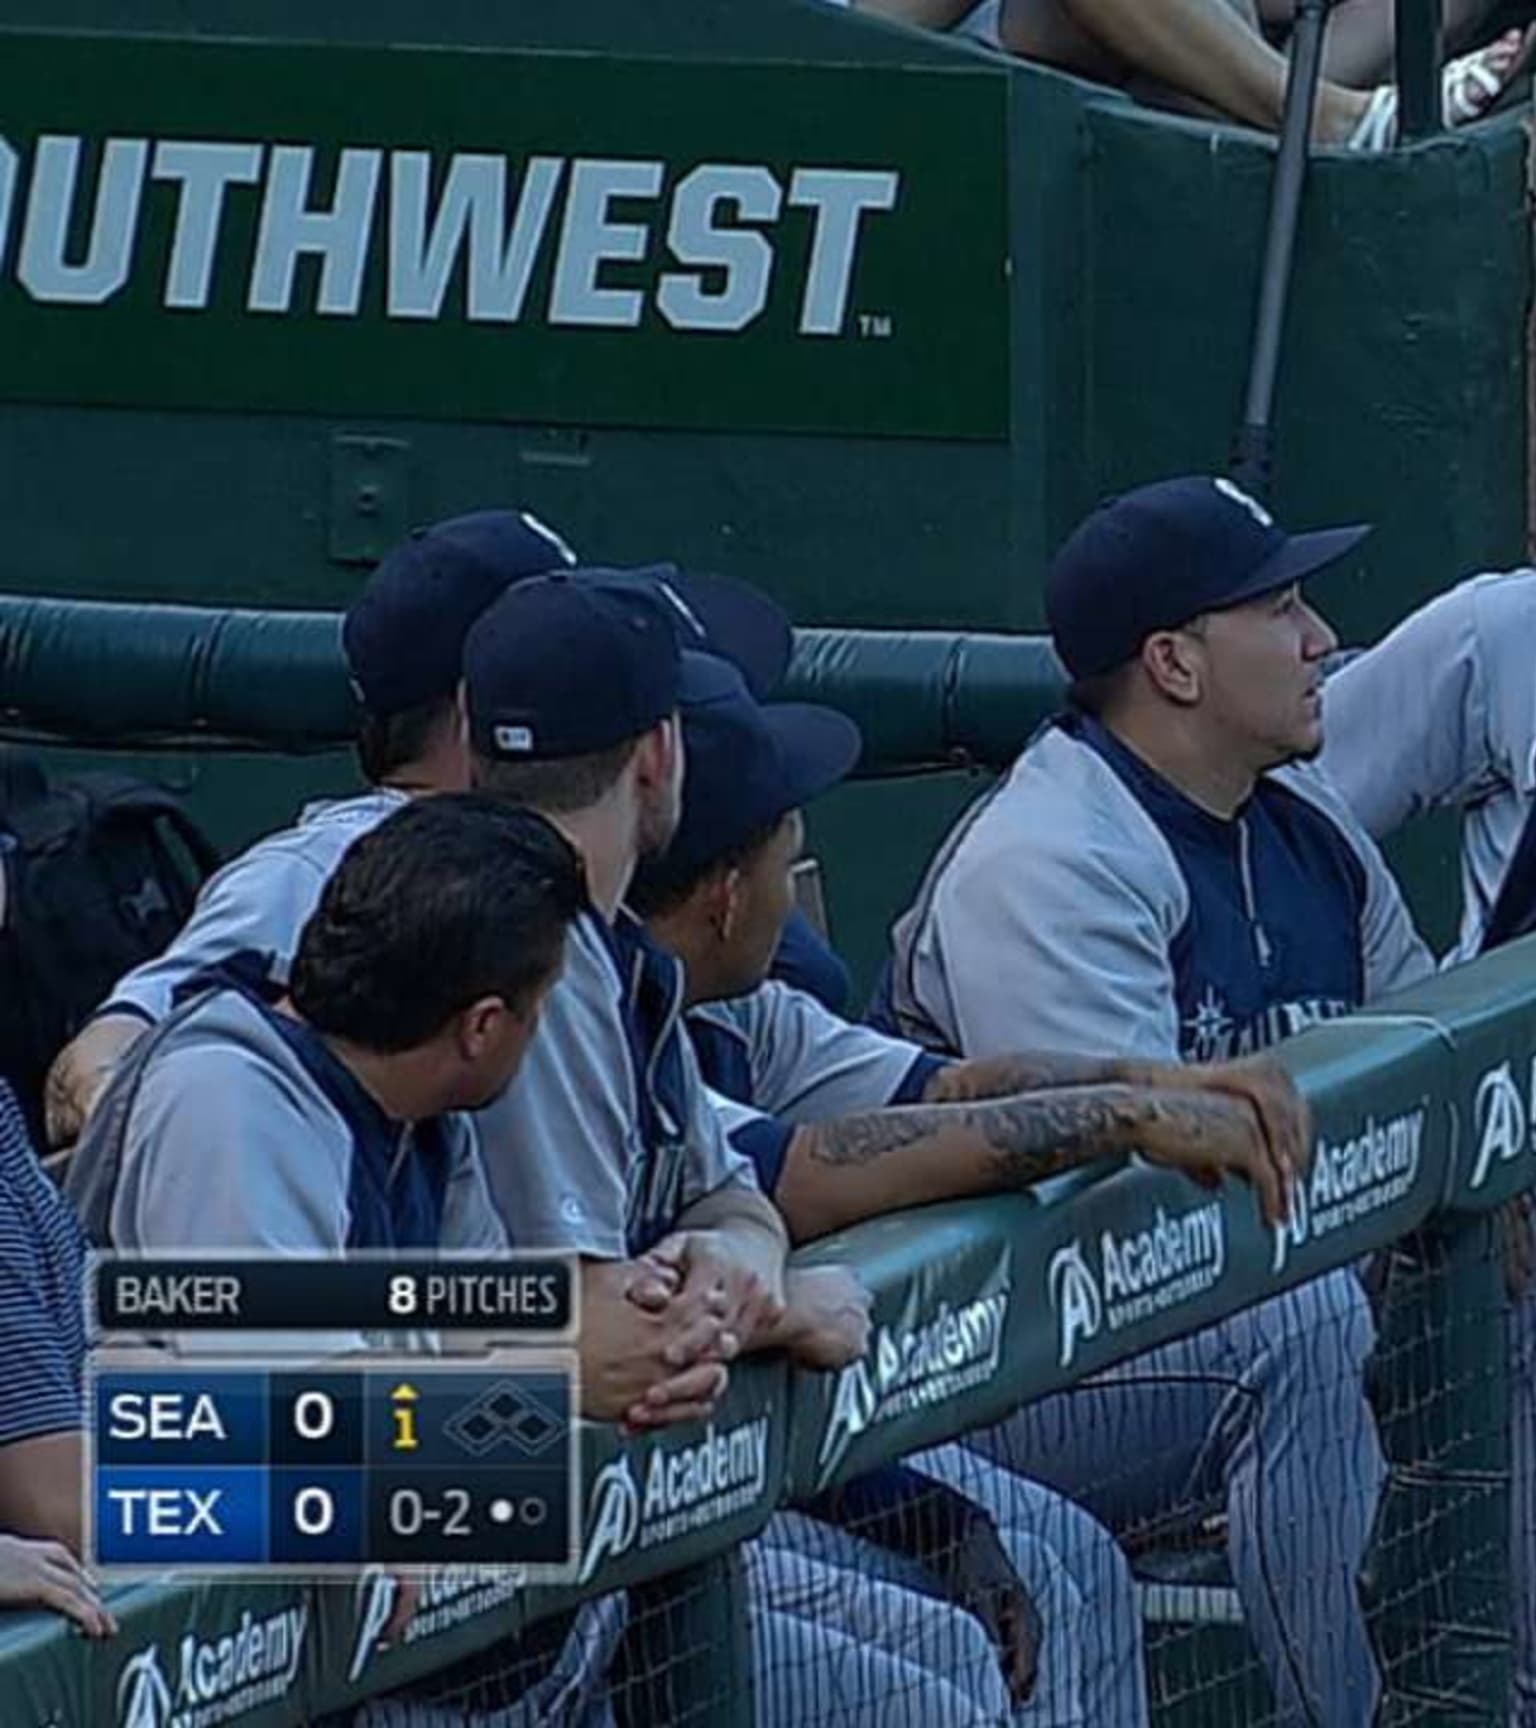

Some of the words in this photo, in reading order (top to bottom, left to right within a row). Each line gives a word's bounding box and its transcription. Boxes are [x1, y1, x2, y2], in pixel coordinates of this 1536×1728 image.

[0, 133, 898, 336] UTHWEST
[1310, 1109, 1423, 1208] Academy
[1102, 1202, 1223, 1301] Academy
[643, 1416, 767, 1519] Academy
